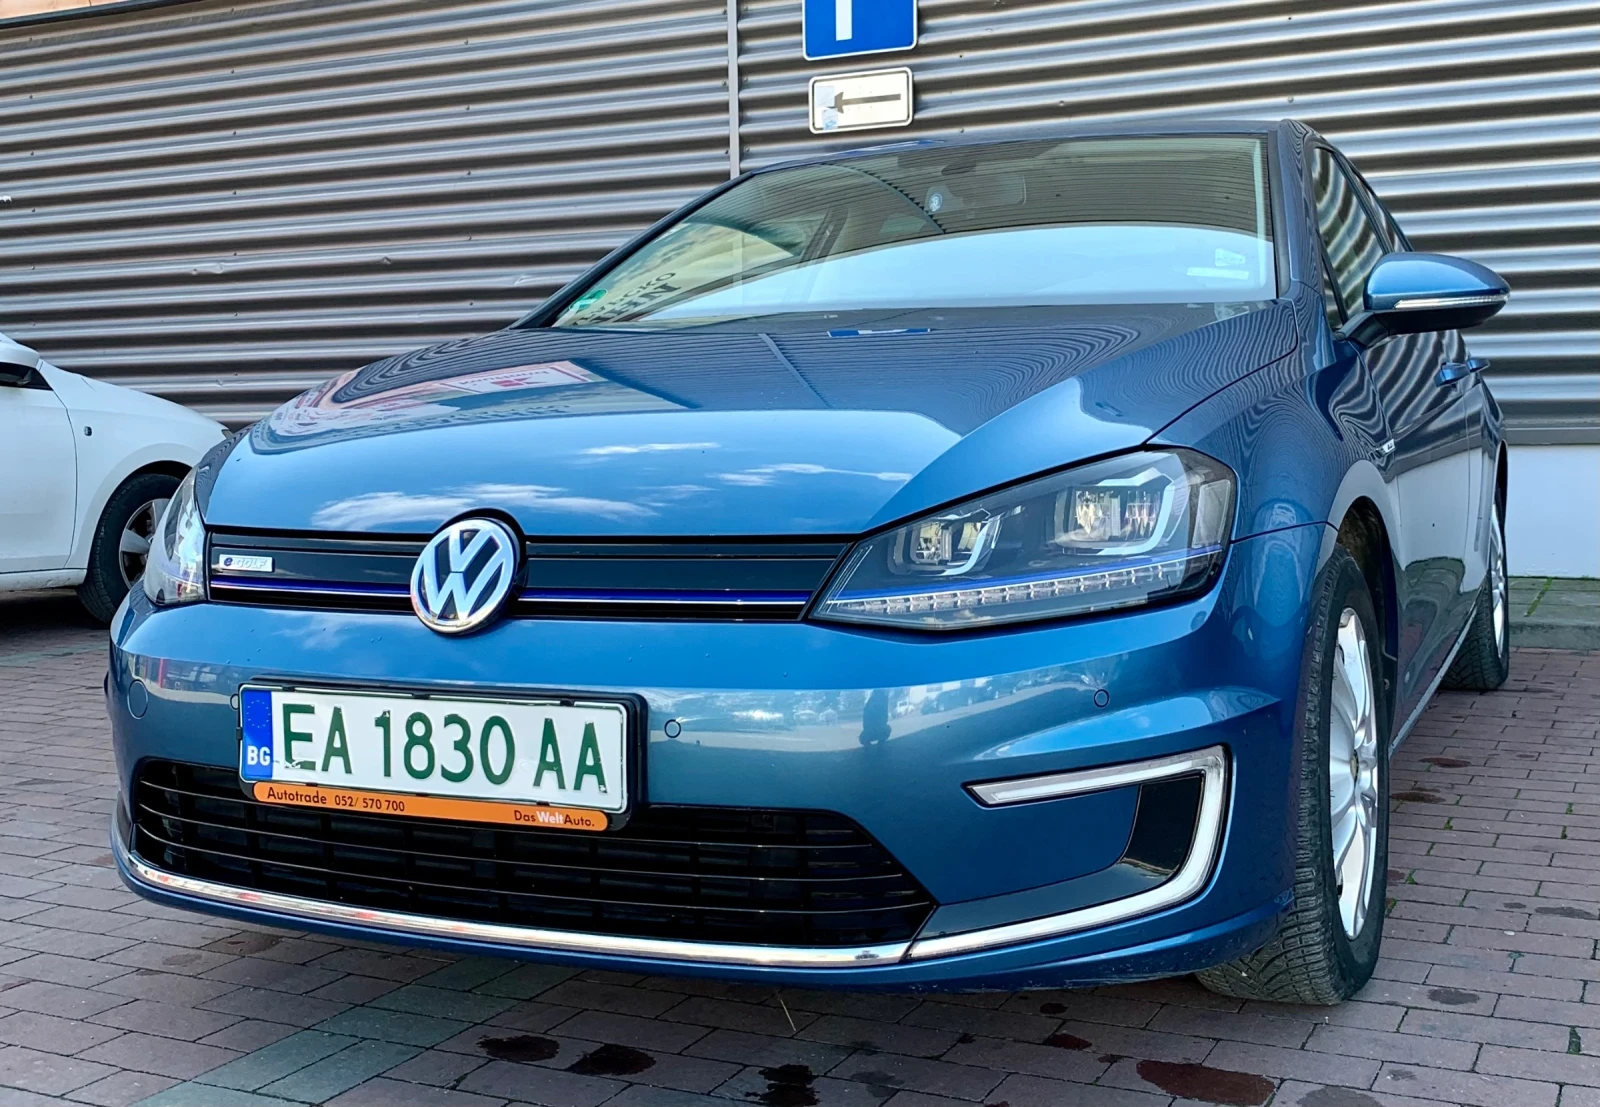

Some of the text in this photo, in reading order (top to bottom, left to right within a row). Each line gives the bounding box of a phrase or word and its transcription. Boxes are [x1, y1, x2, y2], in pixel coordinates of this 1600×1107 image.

[416, 522, 512, 624] VW
[246, 745, 271, 767] BG
[282, 702, 609, 794] EA 1830 AA
[267, 786, 405, 813] Autotrade 052/ 570 700
